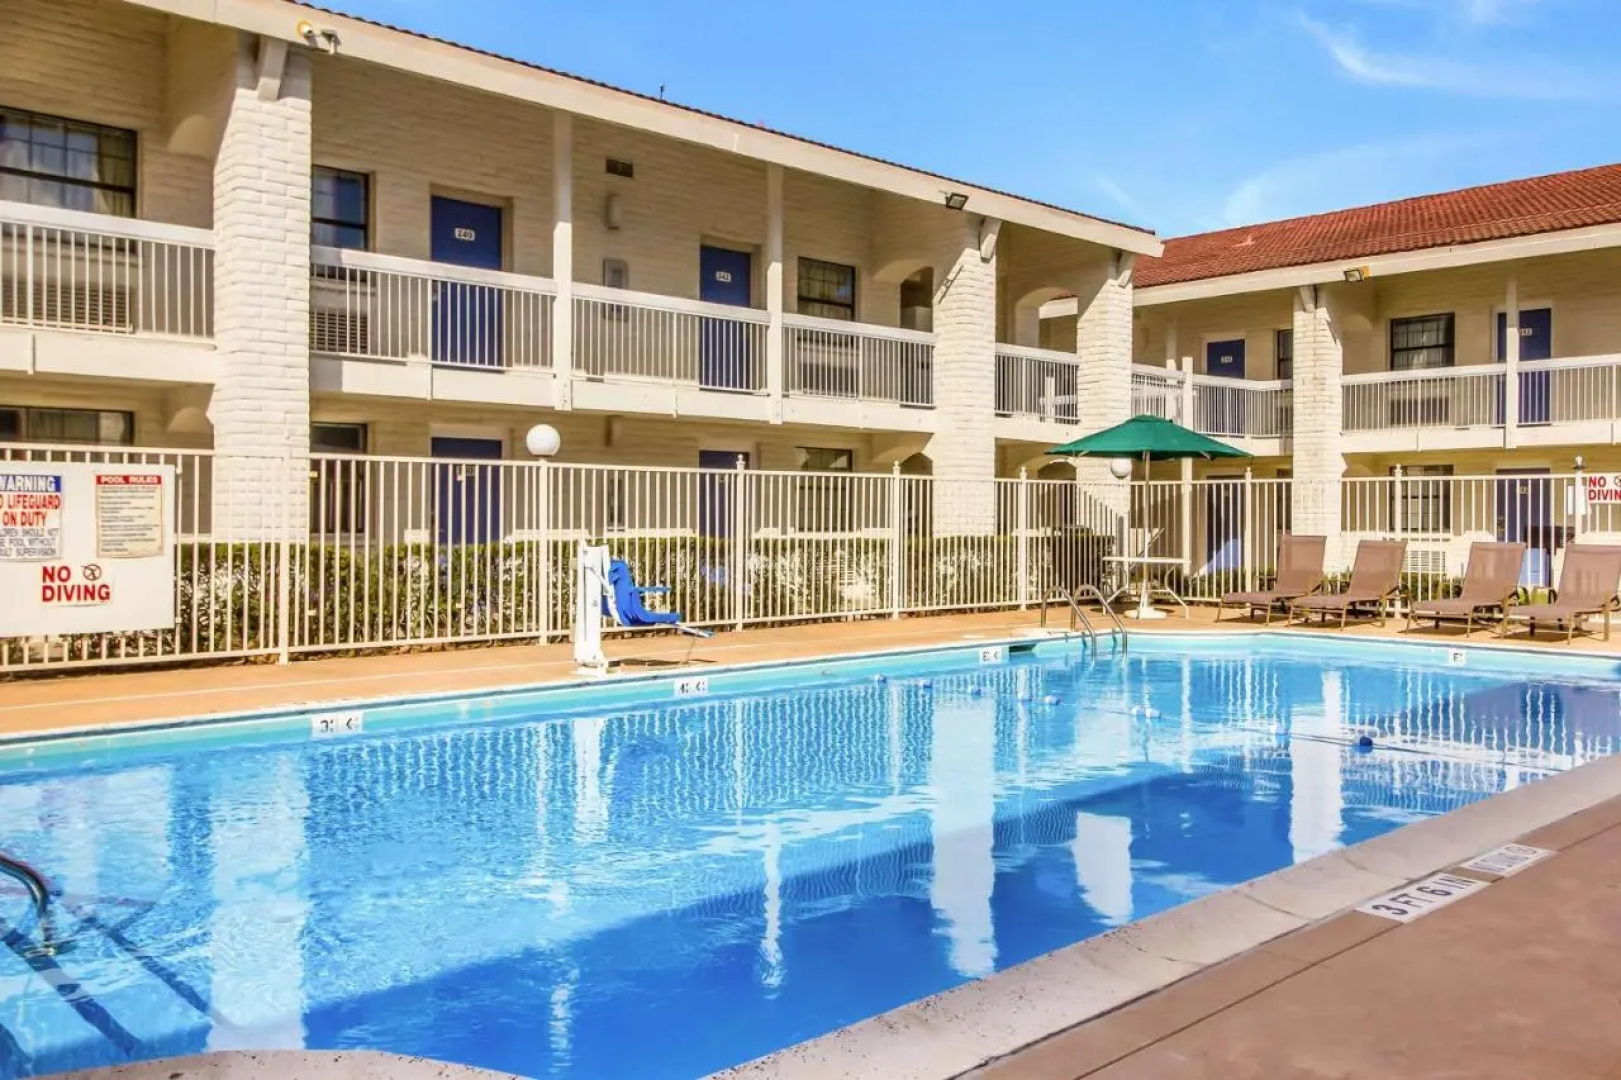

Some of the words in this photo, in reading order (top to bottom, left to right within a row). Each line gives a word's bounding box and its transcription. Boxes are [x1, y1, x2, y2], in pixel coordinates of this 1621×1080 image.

[101, 475, 126, 484] POOL
[129, 475, 158, 484] RULES
[1588, 476, 1607, 487] NO
[7, 494, 61, 510] LIFEGUARD
[1588, 489, 1621, 501] DIVIN
[3, 511, 17, 526] ON
[20, 511, 47, 526] DUTY
[42, 565, 71, 583] NO
[42, 584, 110, 603] DIVING
